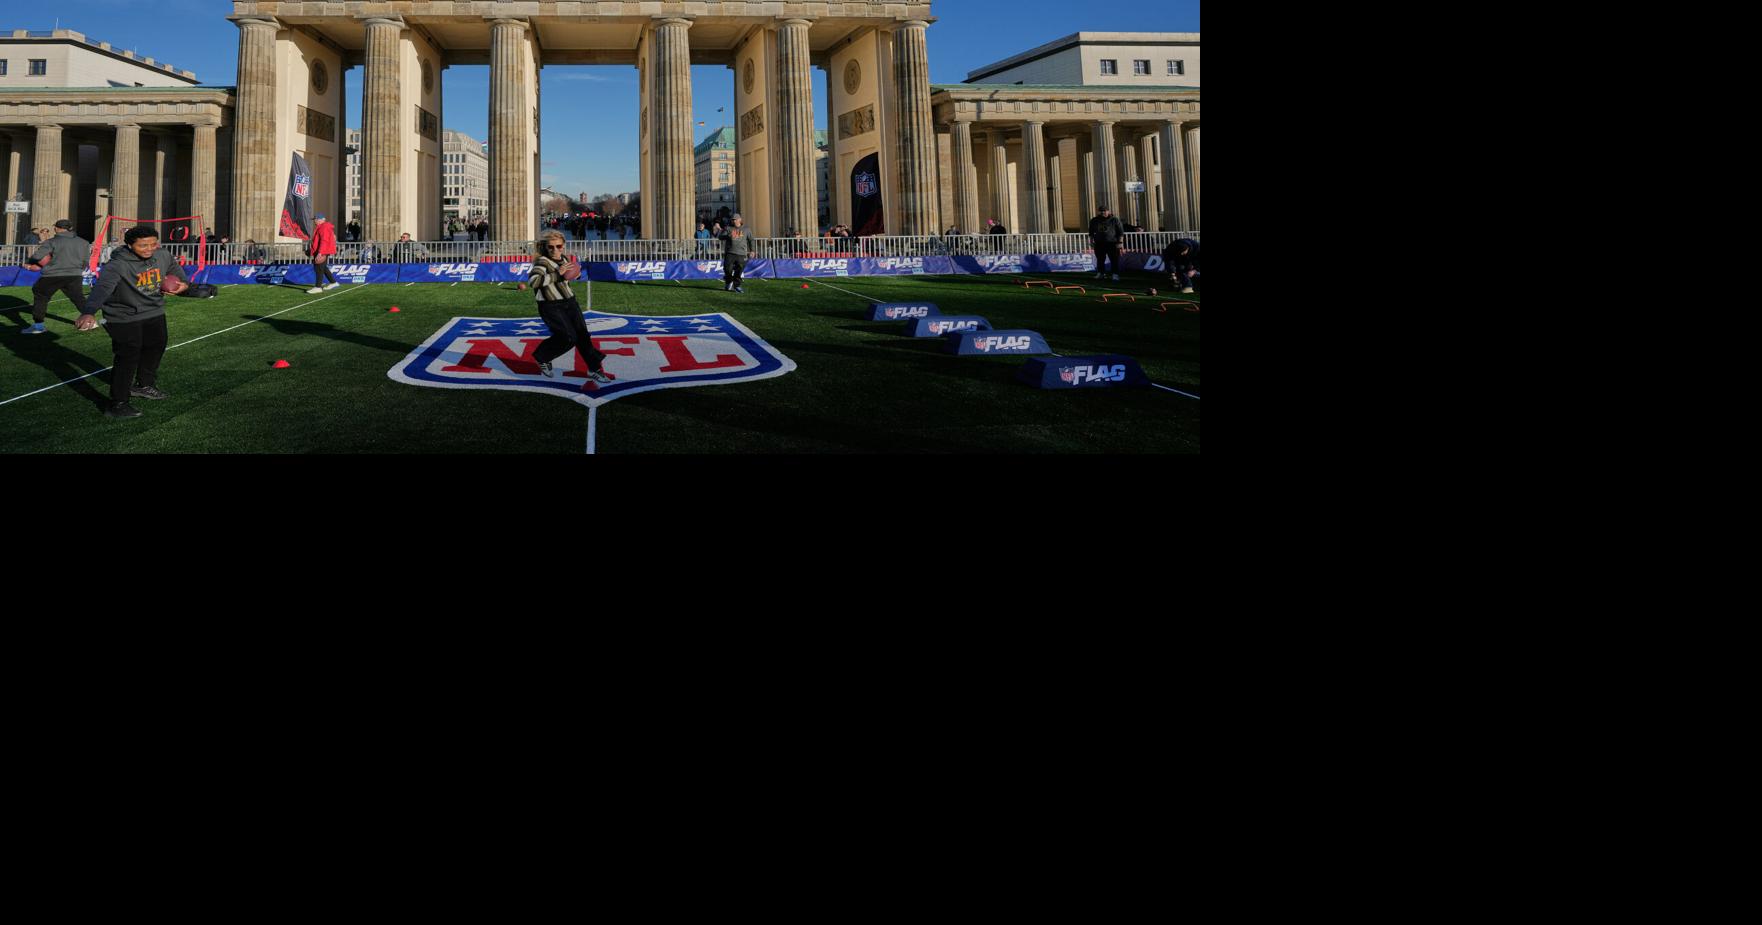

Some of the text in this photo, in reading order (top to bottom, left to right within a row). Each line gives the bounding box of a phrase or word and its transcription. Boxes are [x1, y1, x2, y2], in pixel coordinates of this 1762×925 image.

[810, 259, 848, 271] FLAG
[887, 257, 923, 270] FLAG
[986, 255, 1021, 267] FLAG
[1058, 254, 1093, 266] FLAG
[330, 265, 371, 276] FLAG
[435, 264, 479, 276] FLAG
[516, 263, 533, 275] FL
[625, 262, 667, 275] FLAG
[705, 261, 724, 273] FL
[893, 307, 928, 319] FLAG
[938, 321, 978, 335] FLAG
[985, 336, 1031, 352] FLAG
[441, 336, 746, 380] NFL
[1073, 364, 1126, 385] FLAG
